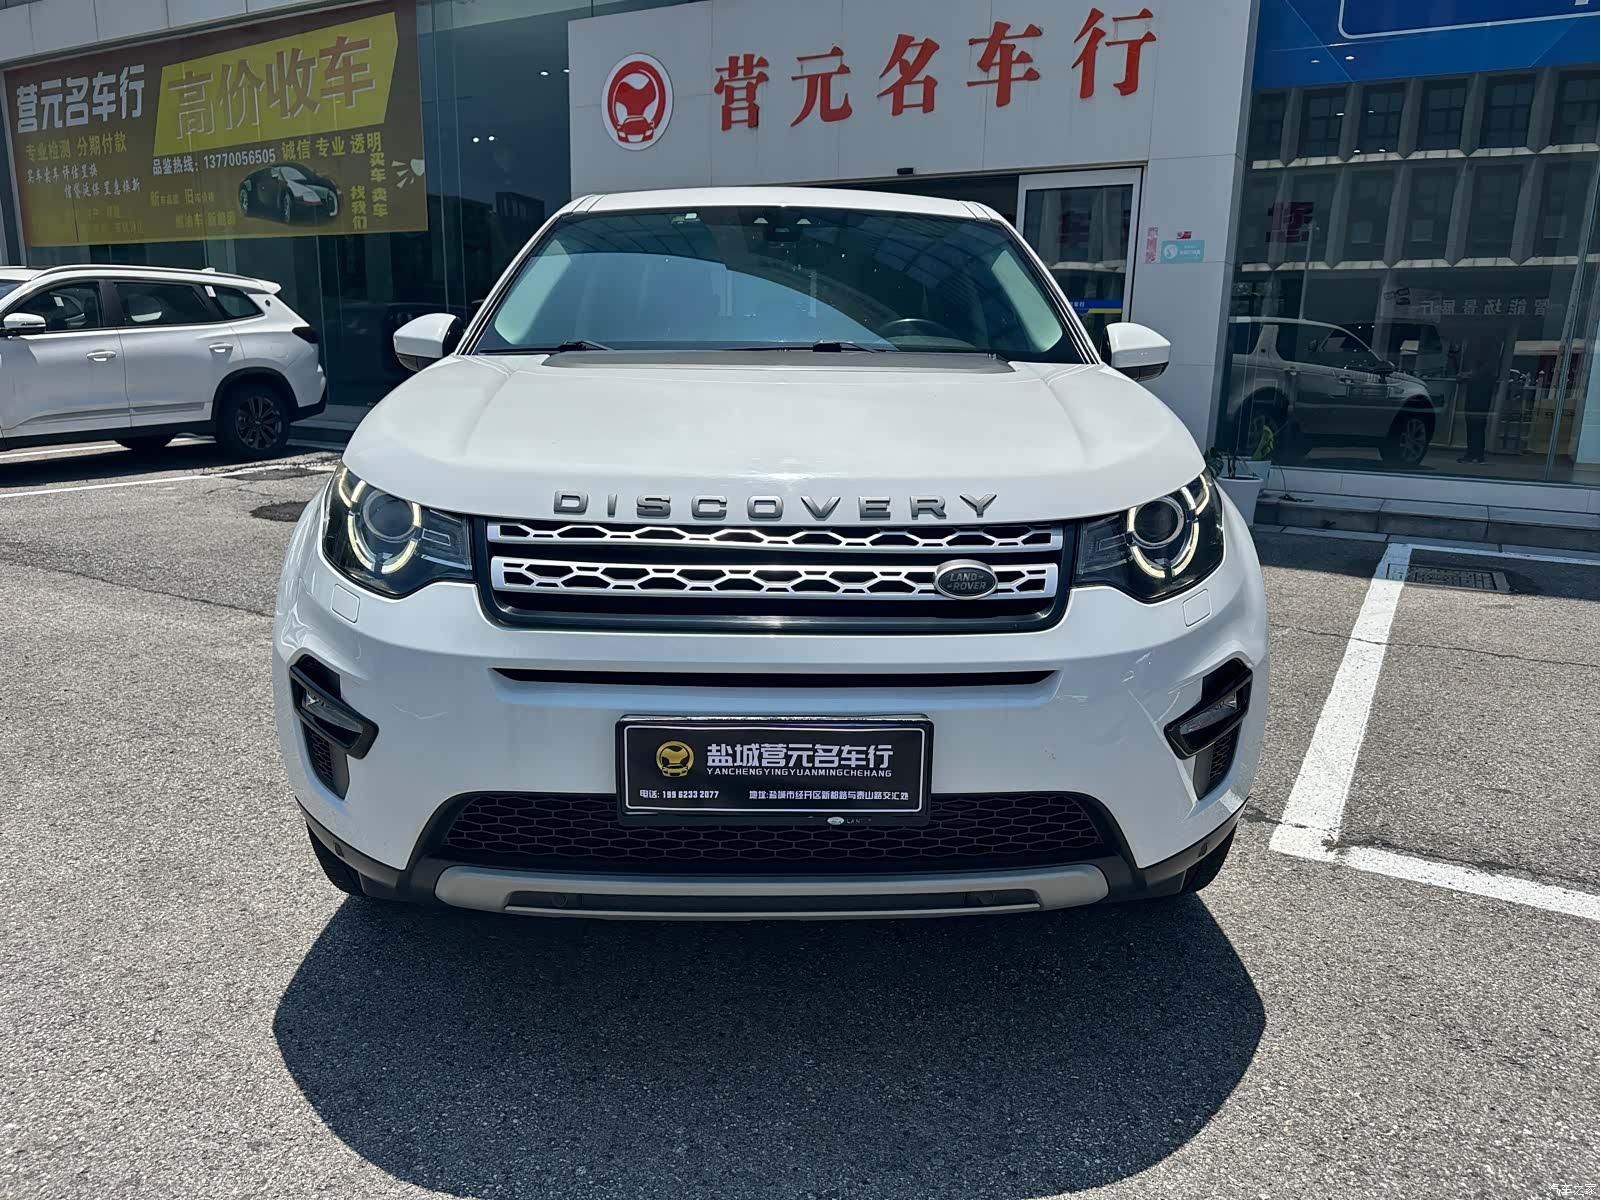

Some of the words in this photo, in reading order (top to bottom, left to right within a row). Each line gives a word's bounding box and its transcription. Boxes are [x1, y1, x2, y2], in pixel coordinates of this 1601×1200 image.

[713, 7, 1157, 132] 营元名车行
[16, 64, 145, 133] 营元名车行
[168, 35, 376, 140] 高价收车
[25, 139, 71, 161] 专业检测
[78, 131, 127, 157] 分期付款
[204, 148, 276, 169] 13770056505
[281, 137, 311, 161] 诚信
[315, 133, 345, 157] 专业
[350, 132, 382, 154] 透明
[350, 185, 368, 230] 找我们
[553, 489, 997, 521] DISCOVERY
[949, 572, 978, 582] LAND
[952, 581, 987, 591] ROVER
[706, 743, 894, 769] 盐城营元名车行
[706, 768, 892, 778] YANCHENGYINGYUANMINGCHEHANG
[662, 790, 677, 799] 199
[699, 790, 720, 799] 2077
